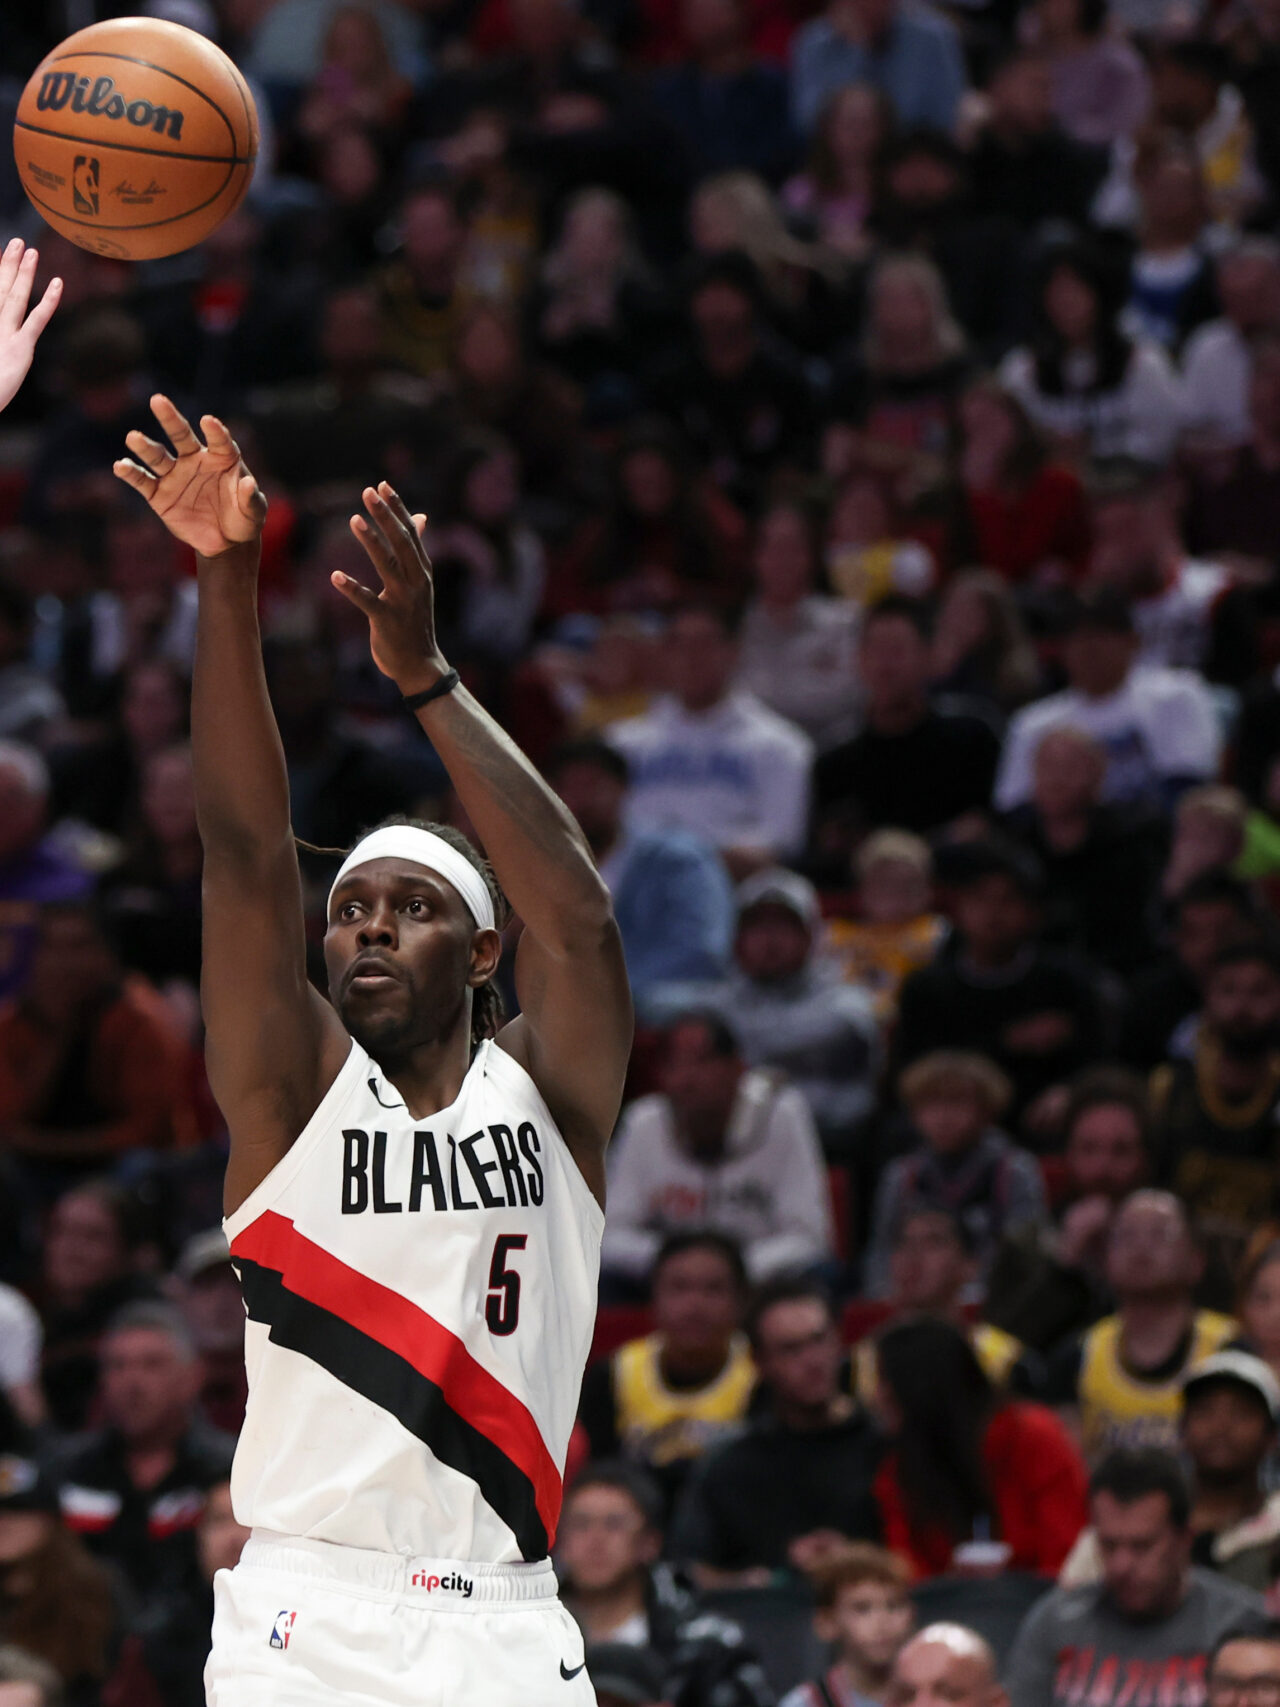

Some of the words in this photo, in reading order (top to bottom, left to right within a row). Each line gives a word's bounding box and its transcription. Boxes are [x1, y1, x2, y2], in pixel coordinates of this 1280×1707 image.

[37, 72, 184, 141] Wilson
[341, 1121, 544, 1215] BLAZERS
[485, 1233, 528, 1337] 5
[412, 1569, 473, 1598] ripcity
